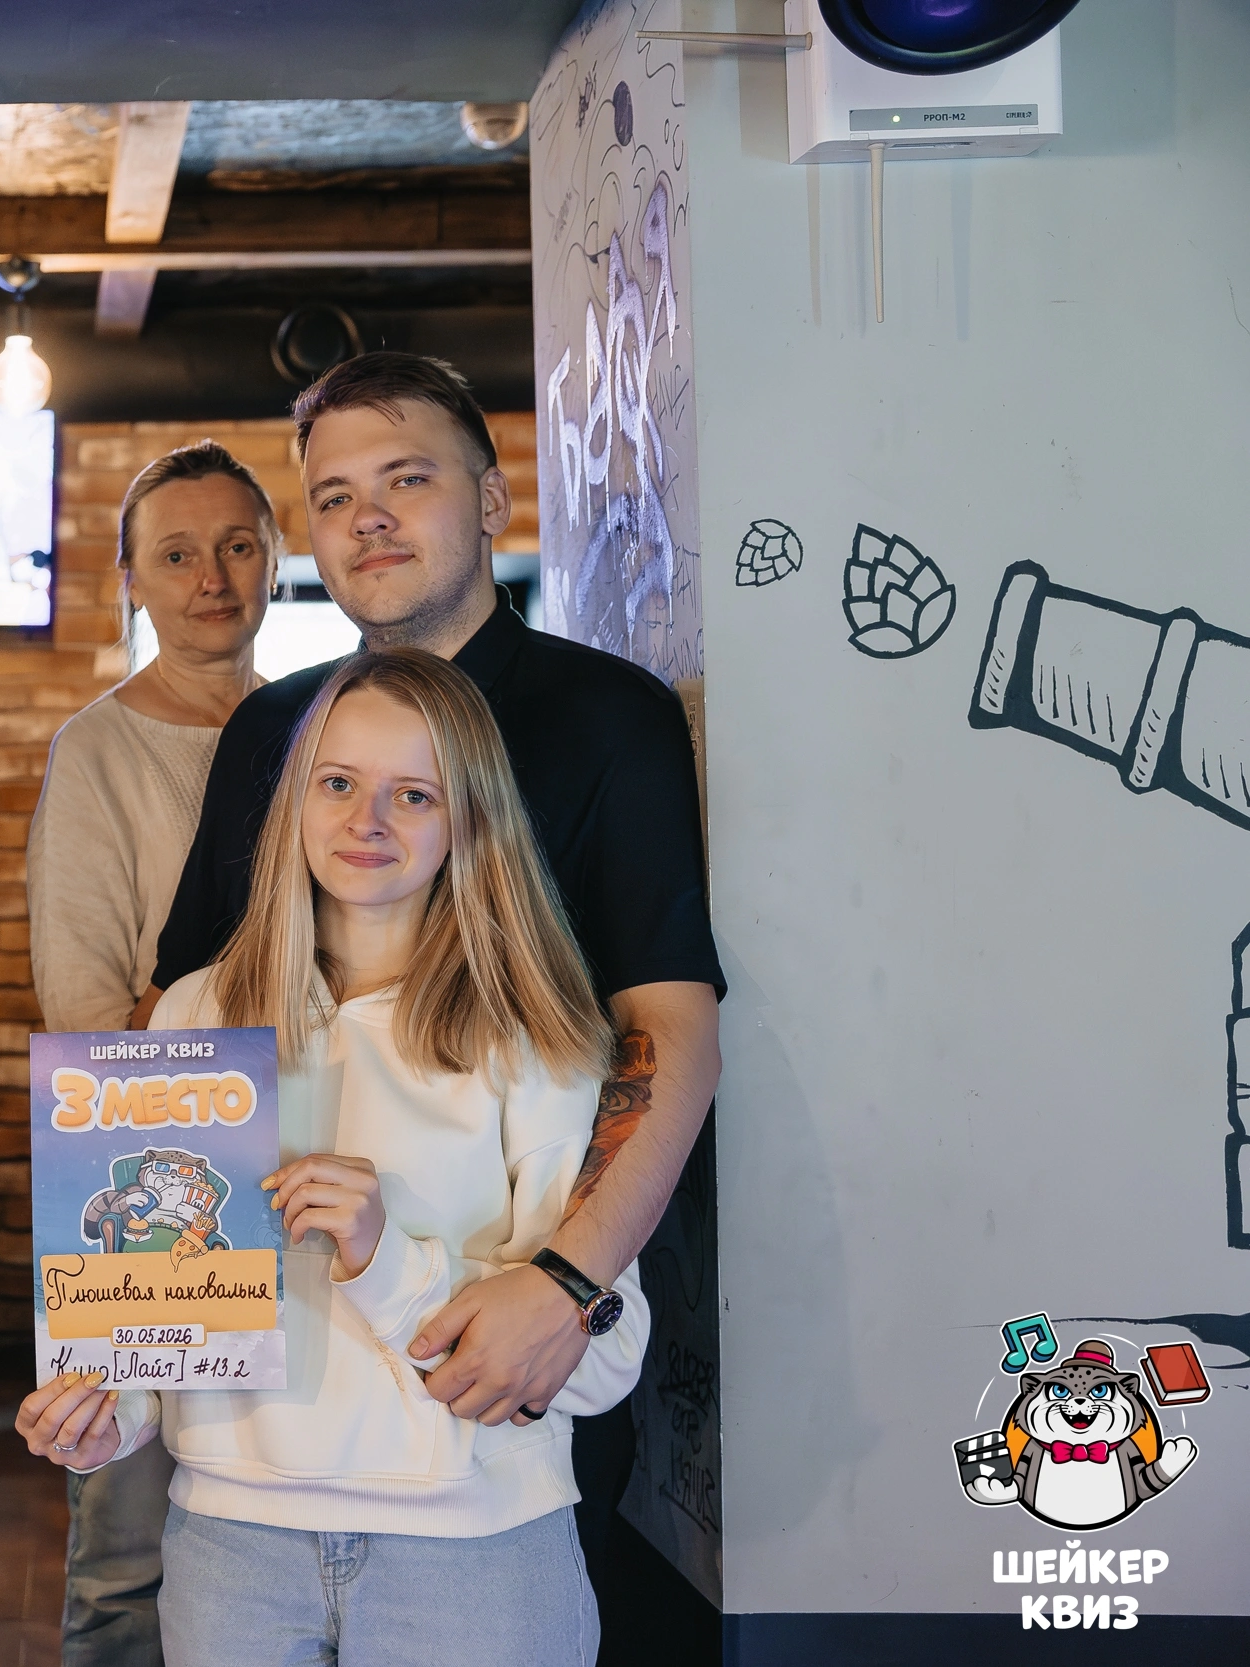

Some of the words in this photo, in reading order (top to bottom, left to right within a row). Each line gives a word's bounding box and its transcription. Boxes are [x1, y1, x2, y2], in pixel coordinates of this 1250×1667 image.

[923, 112, 966, 122] РРОП-М2
[89, 1040, 161, 1060] ШЕЙКЕР
[166, 1041, 215, 1059] КВИЗ
[100, 1074, 254, 1126] МЕСТО
[46, 1252, 156, 1311] Плюшевая
[164, 1270, 273, 1302] наковальня
[114, 1327, 193, 1345] 30.05.2026
[193, 1357, 251, 1378] #13.2
